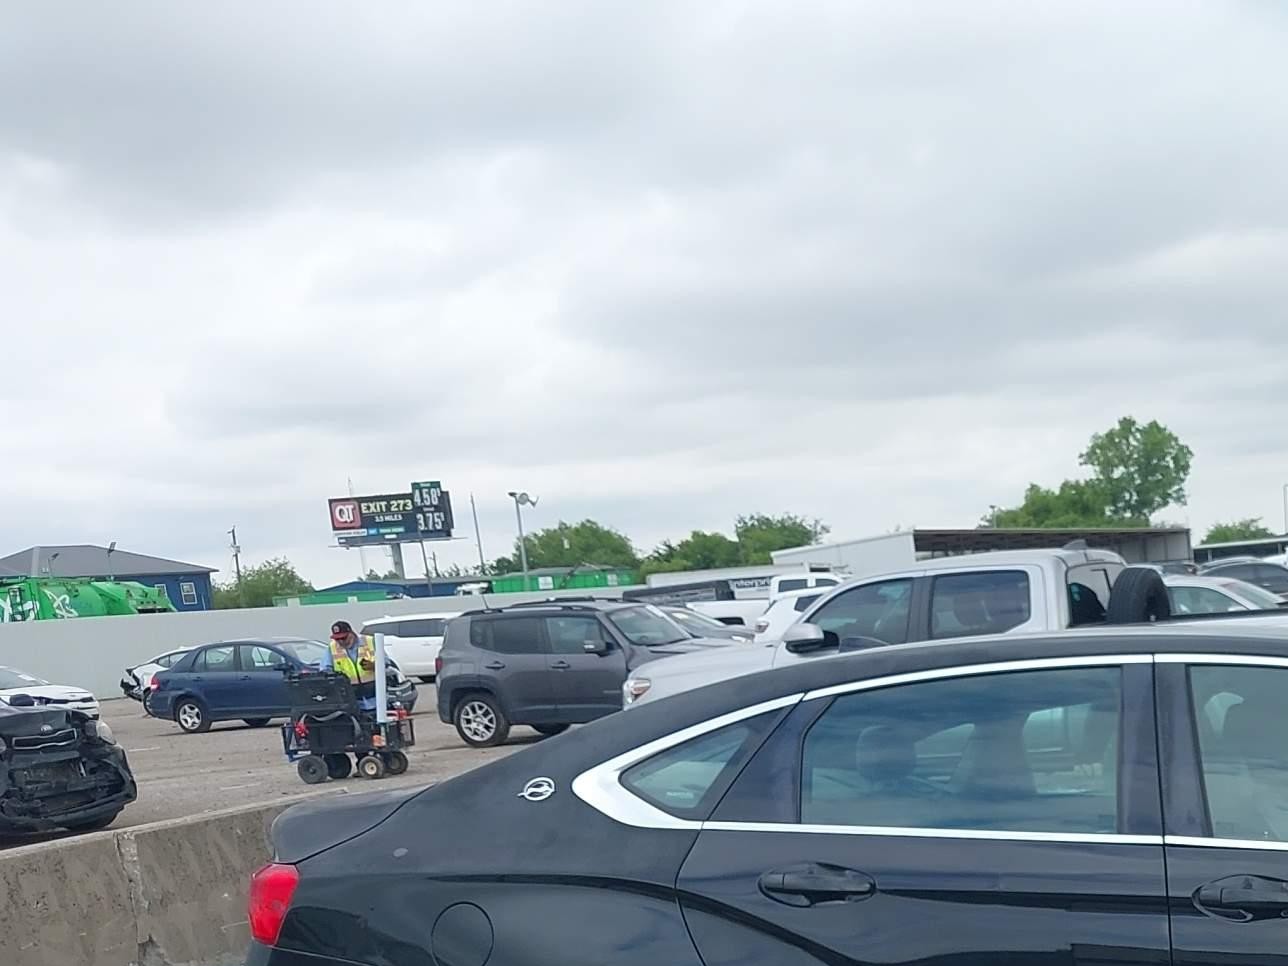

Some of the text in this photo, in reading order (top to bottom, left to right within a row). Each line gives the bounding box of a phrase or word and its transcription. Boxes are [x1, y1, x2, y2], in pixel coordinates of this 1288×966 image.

[335, 504, 355, 523] QT
[360, 500, 387, 514] EXIT
[390, 499, 413, 512] 273
